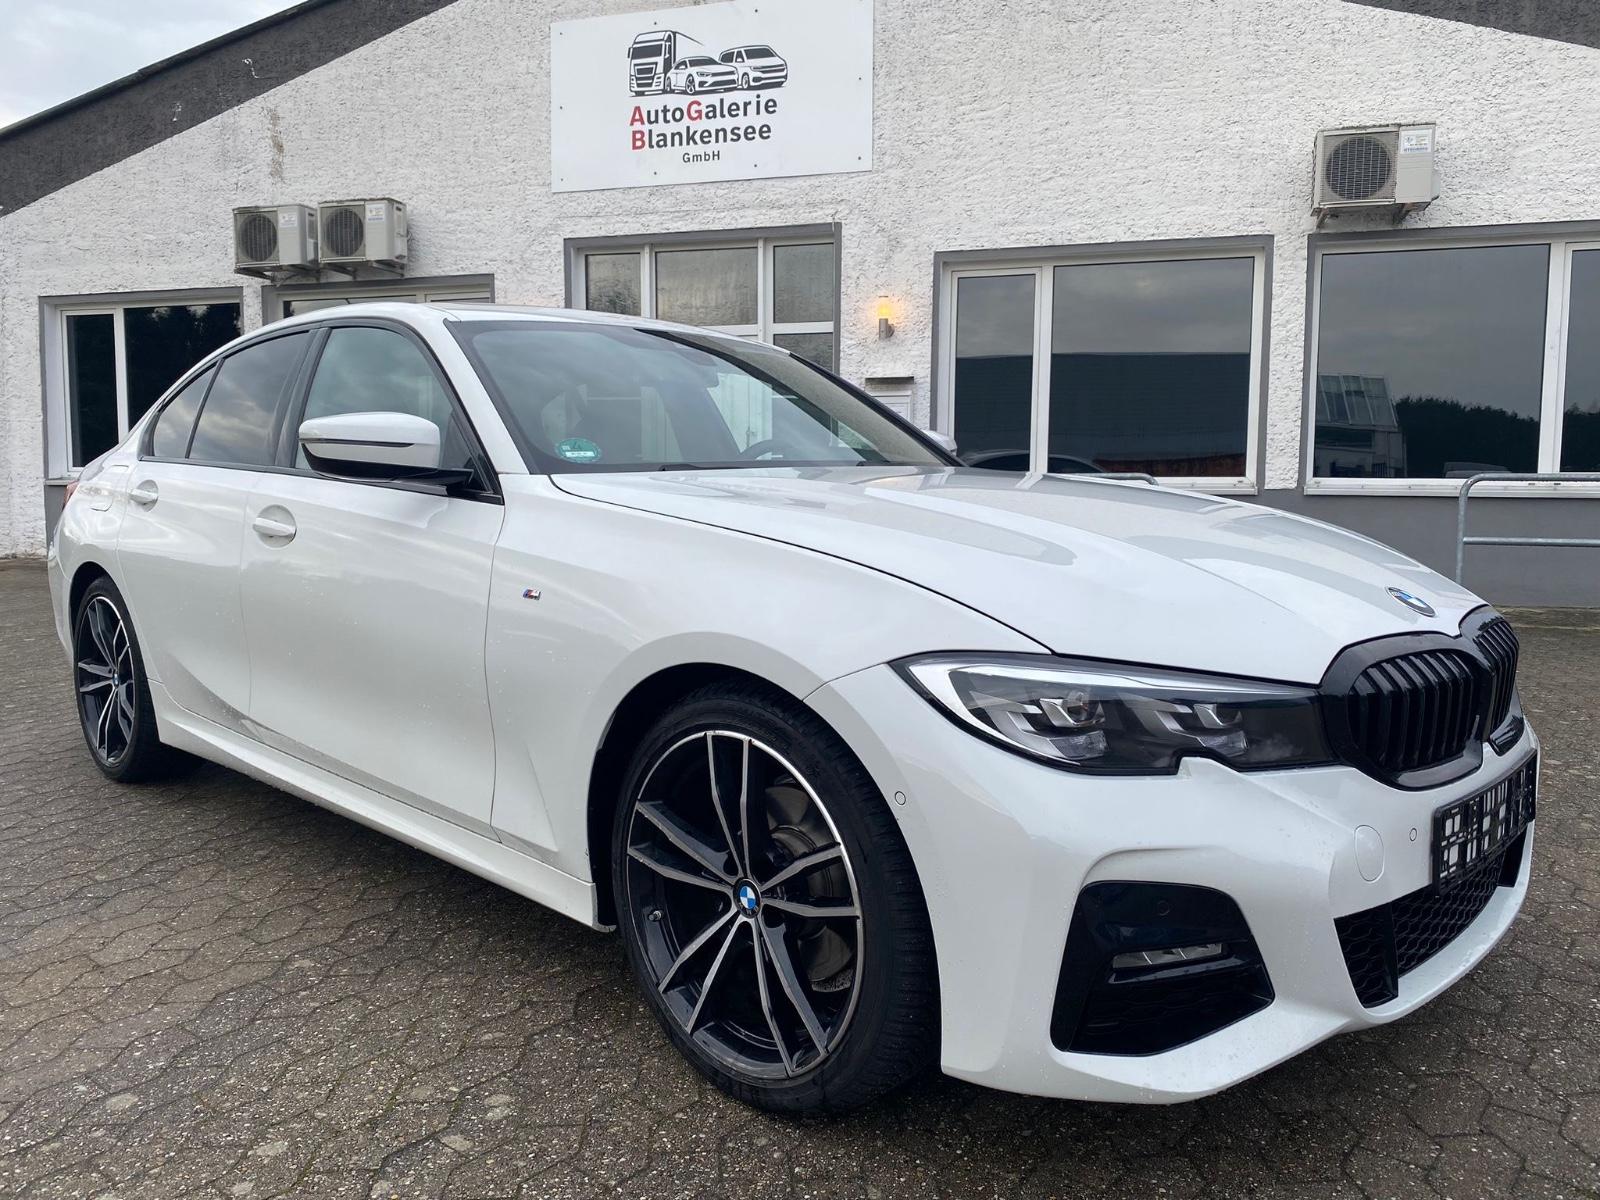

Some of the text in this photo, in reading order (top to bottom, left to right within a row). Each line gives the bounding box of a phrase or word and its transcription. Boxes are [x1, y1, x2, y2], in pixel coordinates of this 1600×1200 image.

[629, 93, 778, 126] AutoGalerie
[631, 123, 772, 150] Blankensee
[682, 150, 720, 163] GmbH
